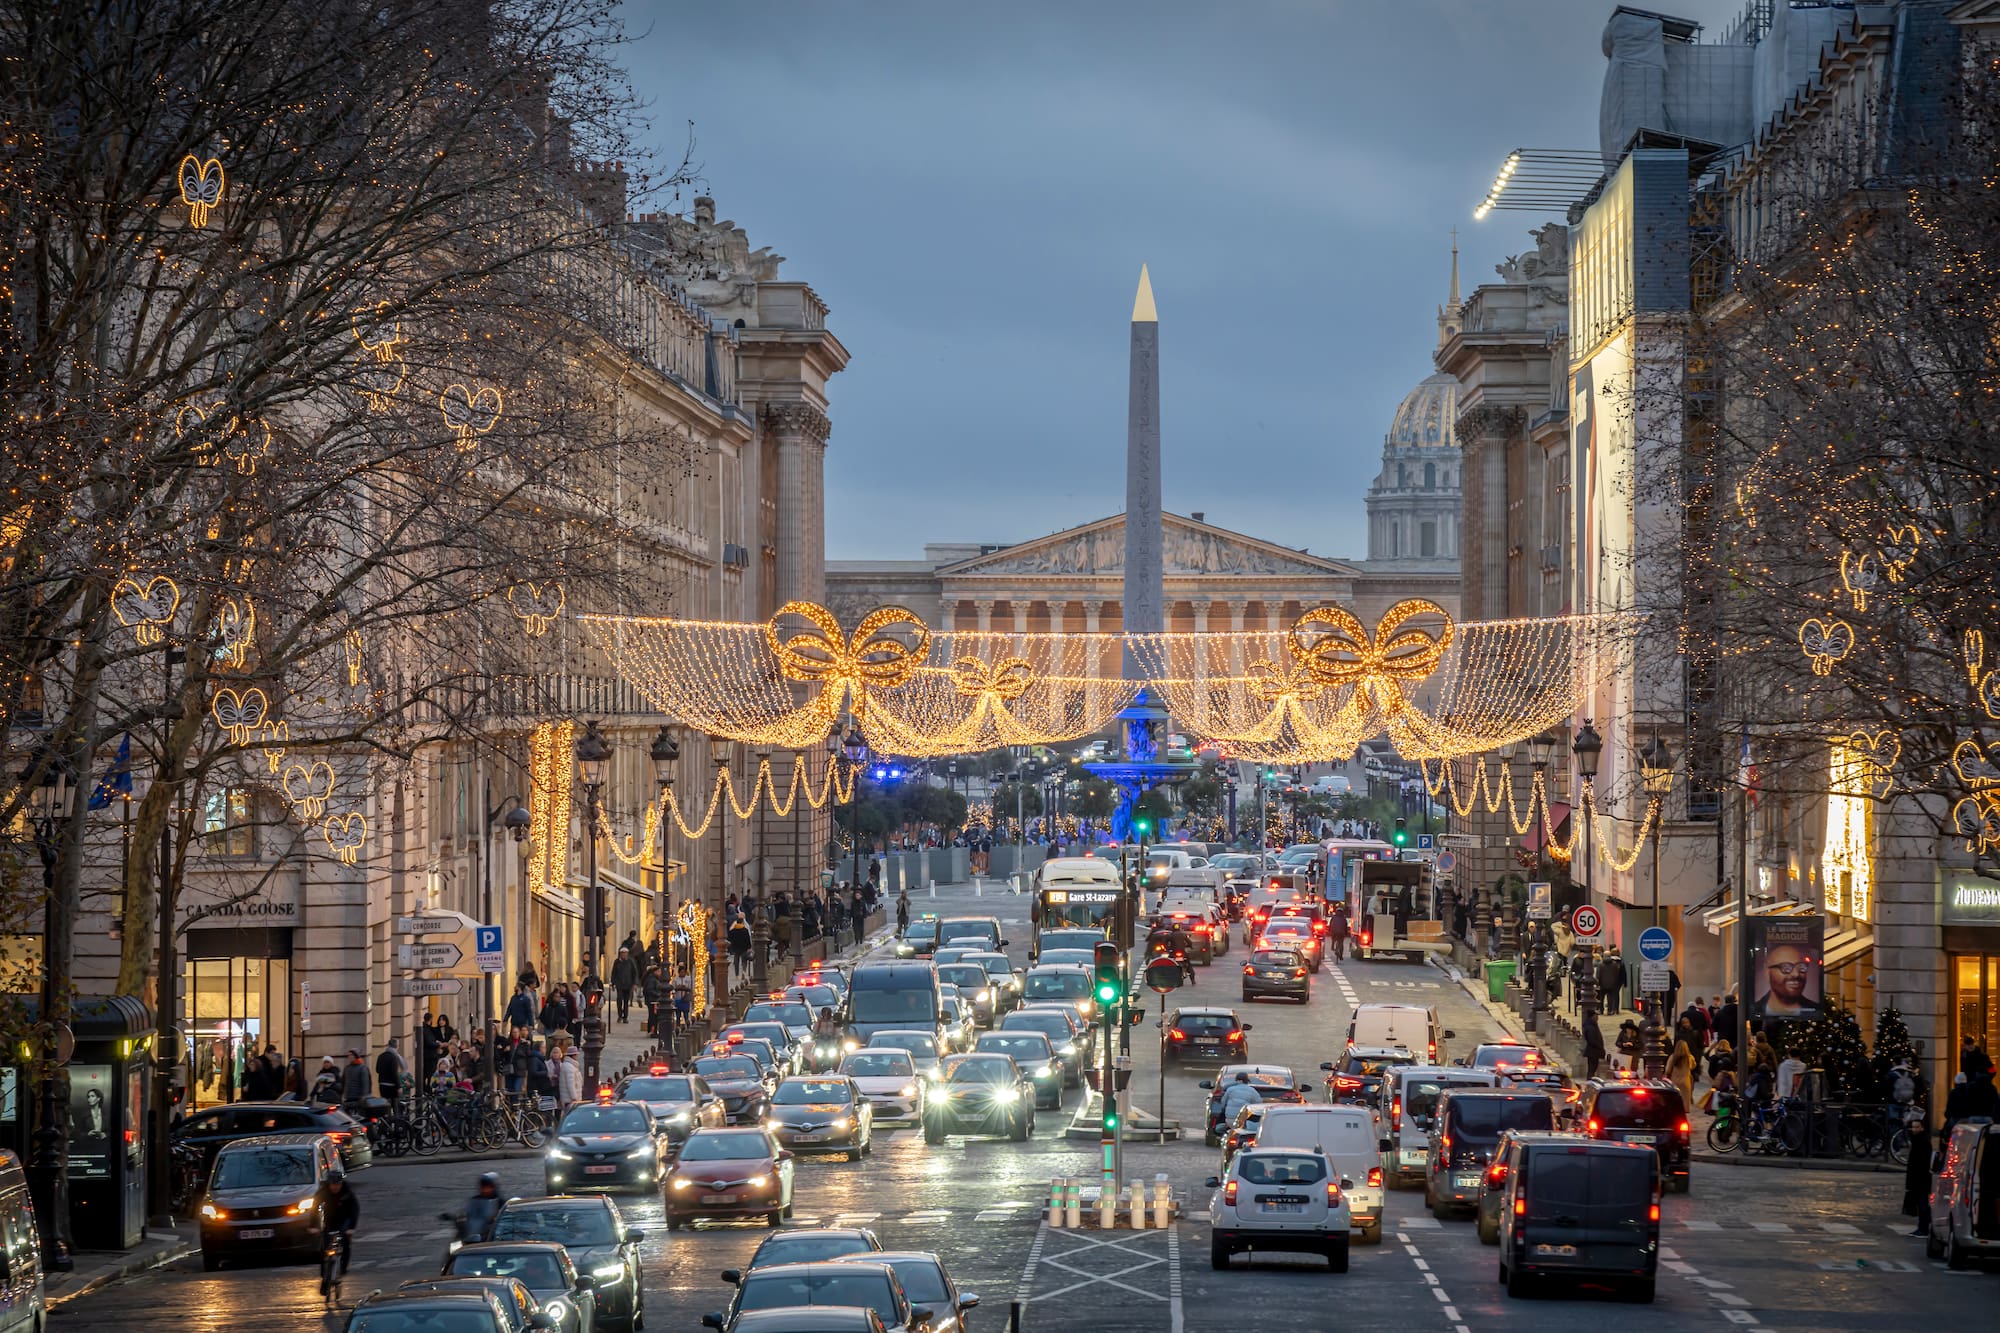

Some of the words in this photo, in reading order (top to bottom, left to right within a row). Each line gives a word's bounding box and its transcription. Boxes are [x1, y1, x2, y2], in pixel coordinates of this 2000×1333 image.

[1069, 893, 1084, 901] Gare
[1534, 887, 1545, 901] P
[248, 903, 295, 915] GOOSE
[412, 922, 441, 930] CONCORDE
[1579, 915, 1596, 928] 50
[482, 931, 496, 949] P
[413, 948, 427, 956] SAINT
